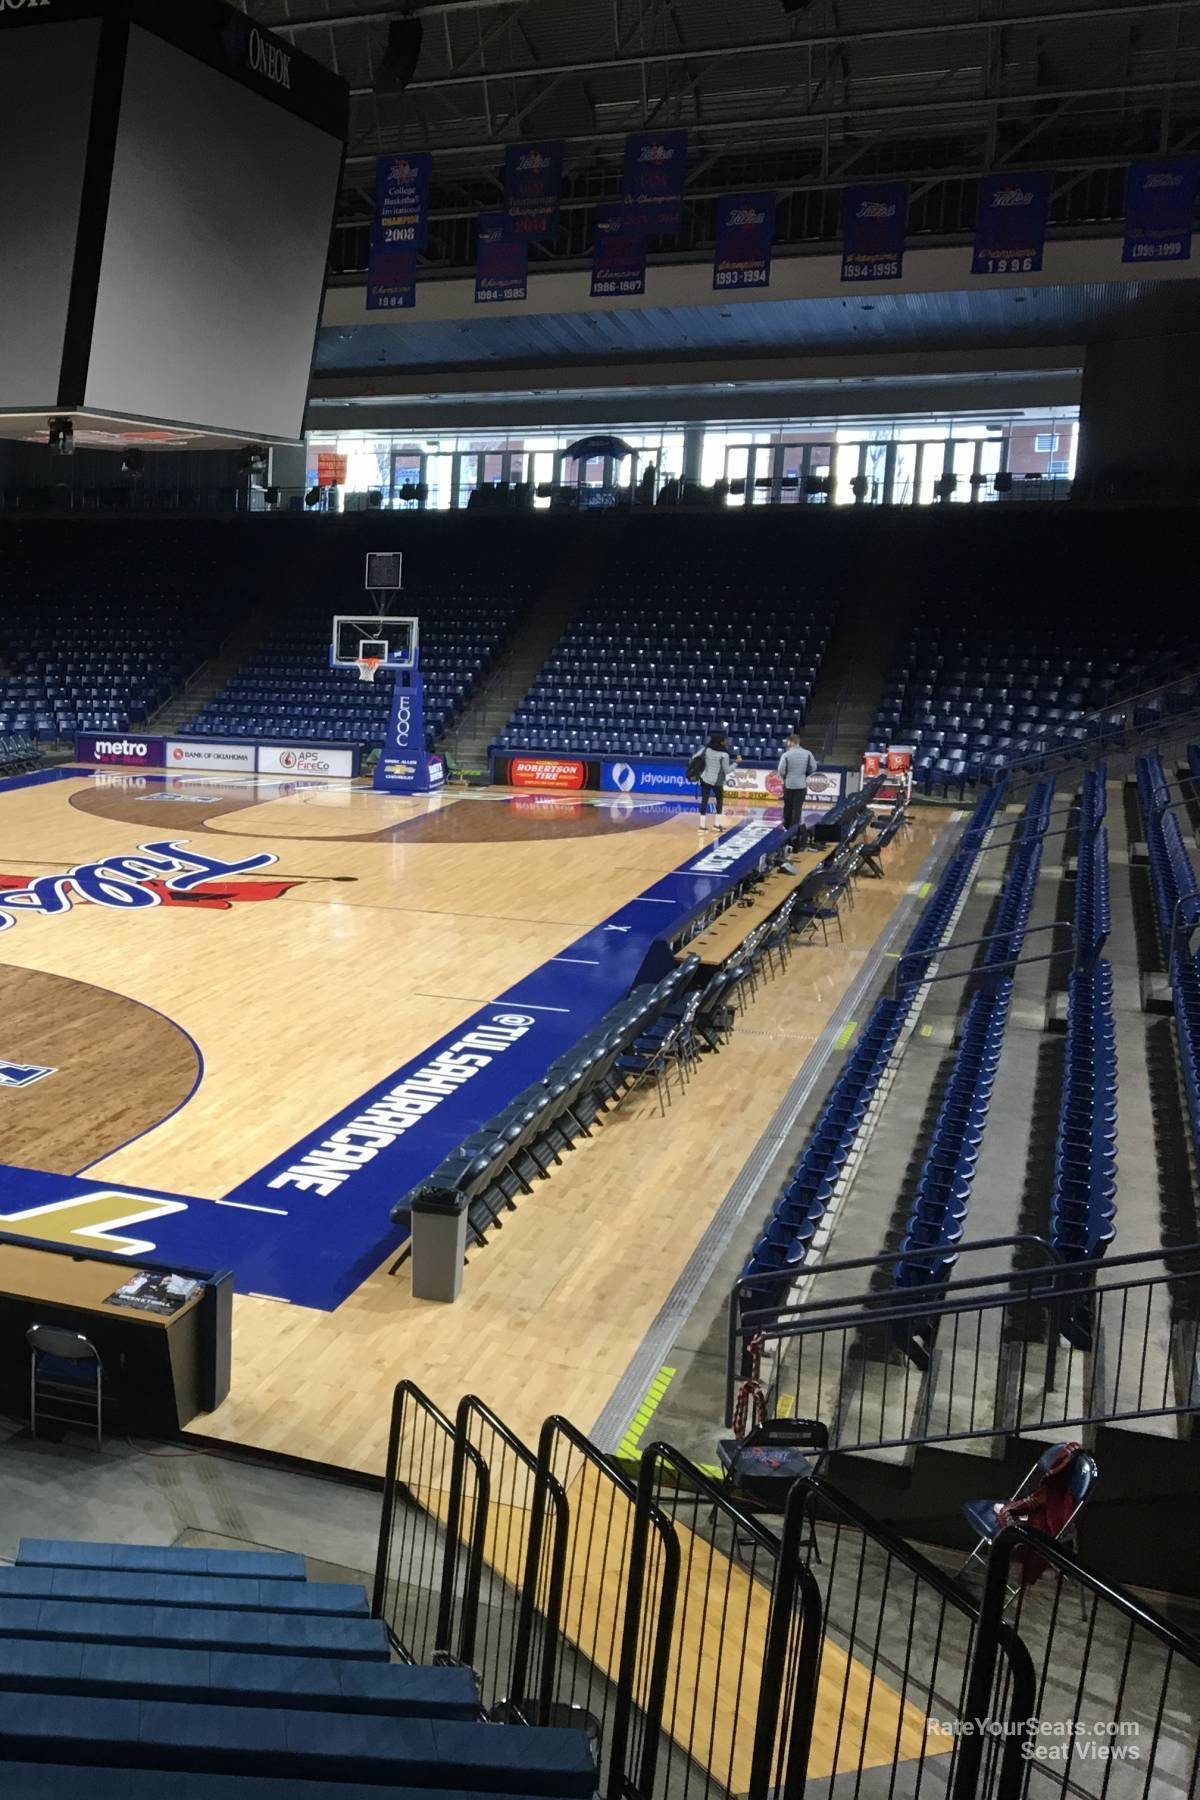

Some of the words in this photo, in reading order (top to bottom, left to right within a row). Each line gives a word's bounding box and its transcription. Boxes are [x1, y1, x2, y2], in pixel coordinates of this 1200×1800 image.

[249, 27, 291, 88] ONEOK
[388, 185, 416, 196] College
[384, 227, 416, 243] 2008
[844, 262, 898, 277] 1994-1995
[987, 258, 1032, 273] 1996
[716, 270, 766, 285] 1993-1994
[94, 740, 148, 758] metro
[298, 752, 318, 761] APS
[297, 760, 329, 770] FireCo
[517, 764, 577, 774] ROBERTSON
[535, 772, 560, 780] TIRE
[641, 771, 701, 787] jdyoung.co
[266, 1014, 535, 1197] @TULSAHURRICANE
